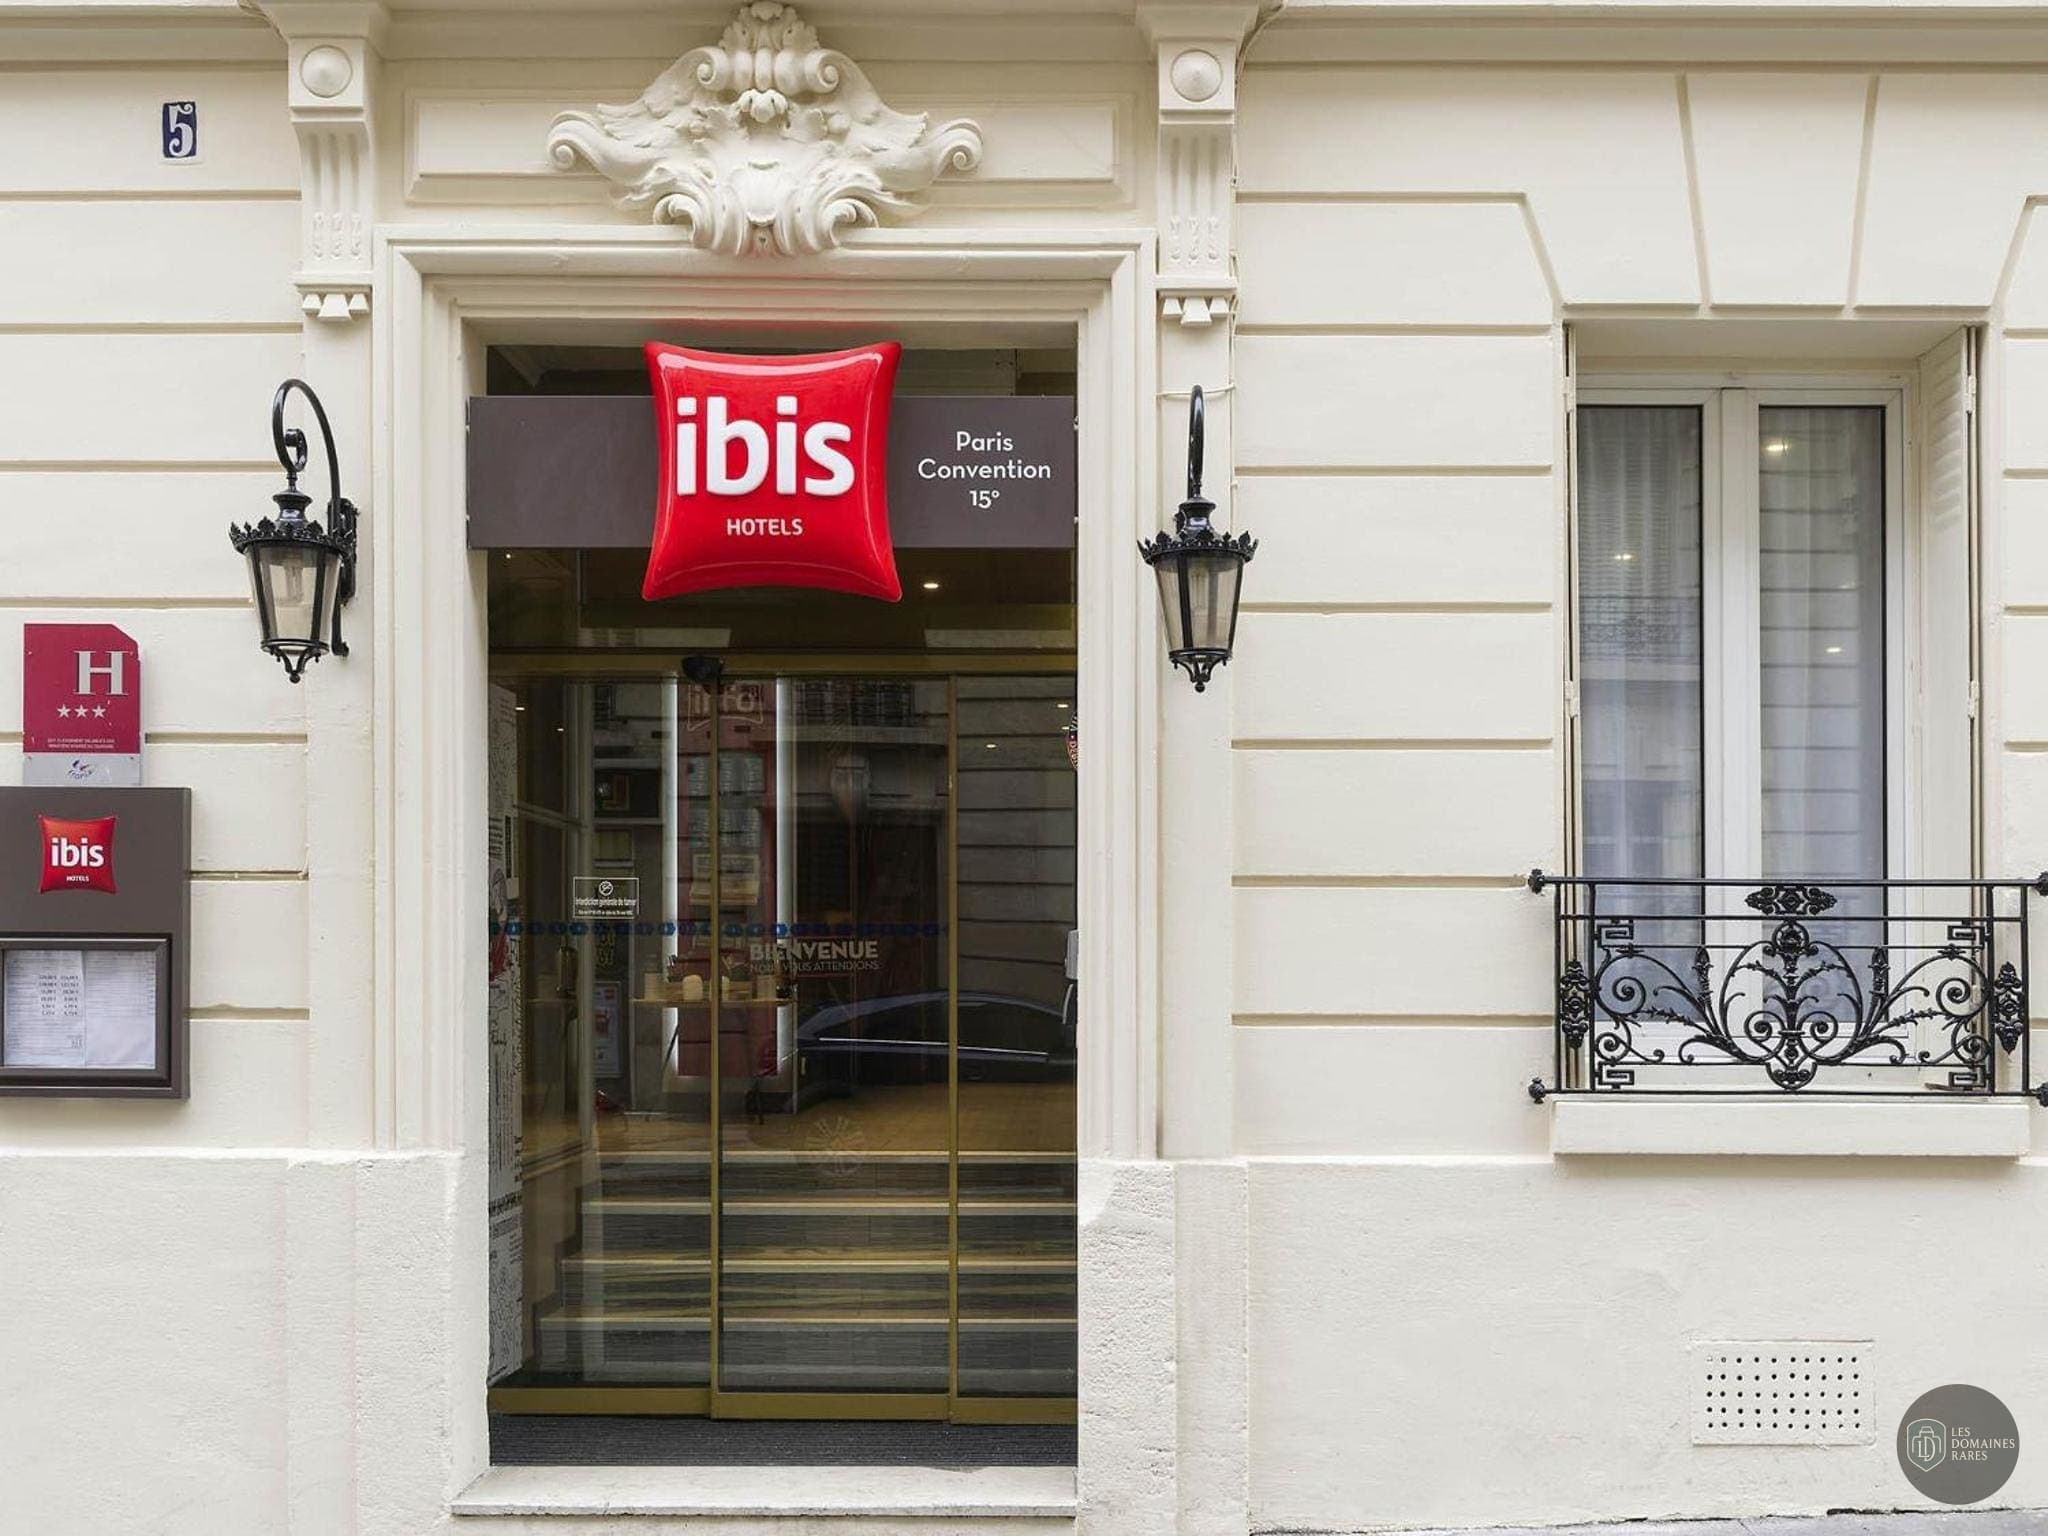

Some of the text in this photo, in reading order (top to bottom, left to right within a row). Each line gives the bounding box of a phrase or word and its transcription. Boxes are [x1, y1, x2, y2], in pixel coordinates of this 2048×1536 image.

[168, 103, 194, 157] 5
[676, 395, 856, 497] ibis
[956, 431, 1014, 451] Paris
[918, 458, 1051, 479] Convention
[726, 517, 804, 537] HOTELS
[73, 650, 128, 695] H
[51, 837, 105, 868] ibis
[749, 939, 879, 961] BIENVENUE
